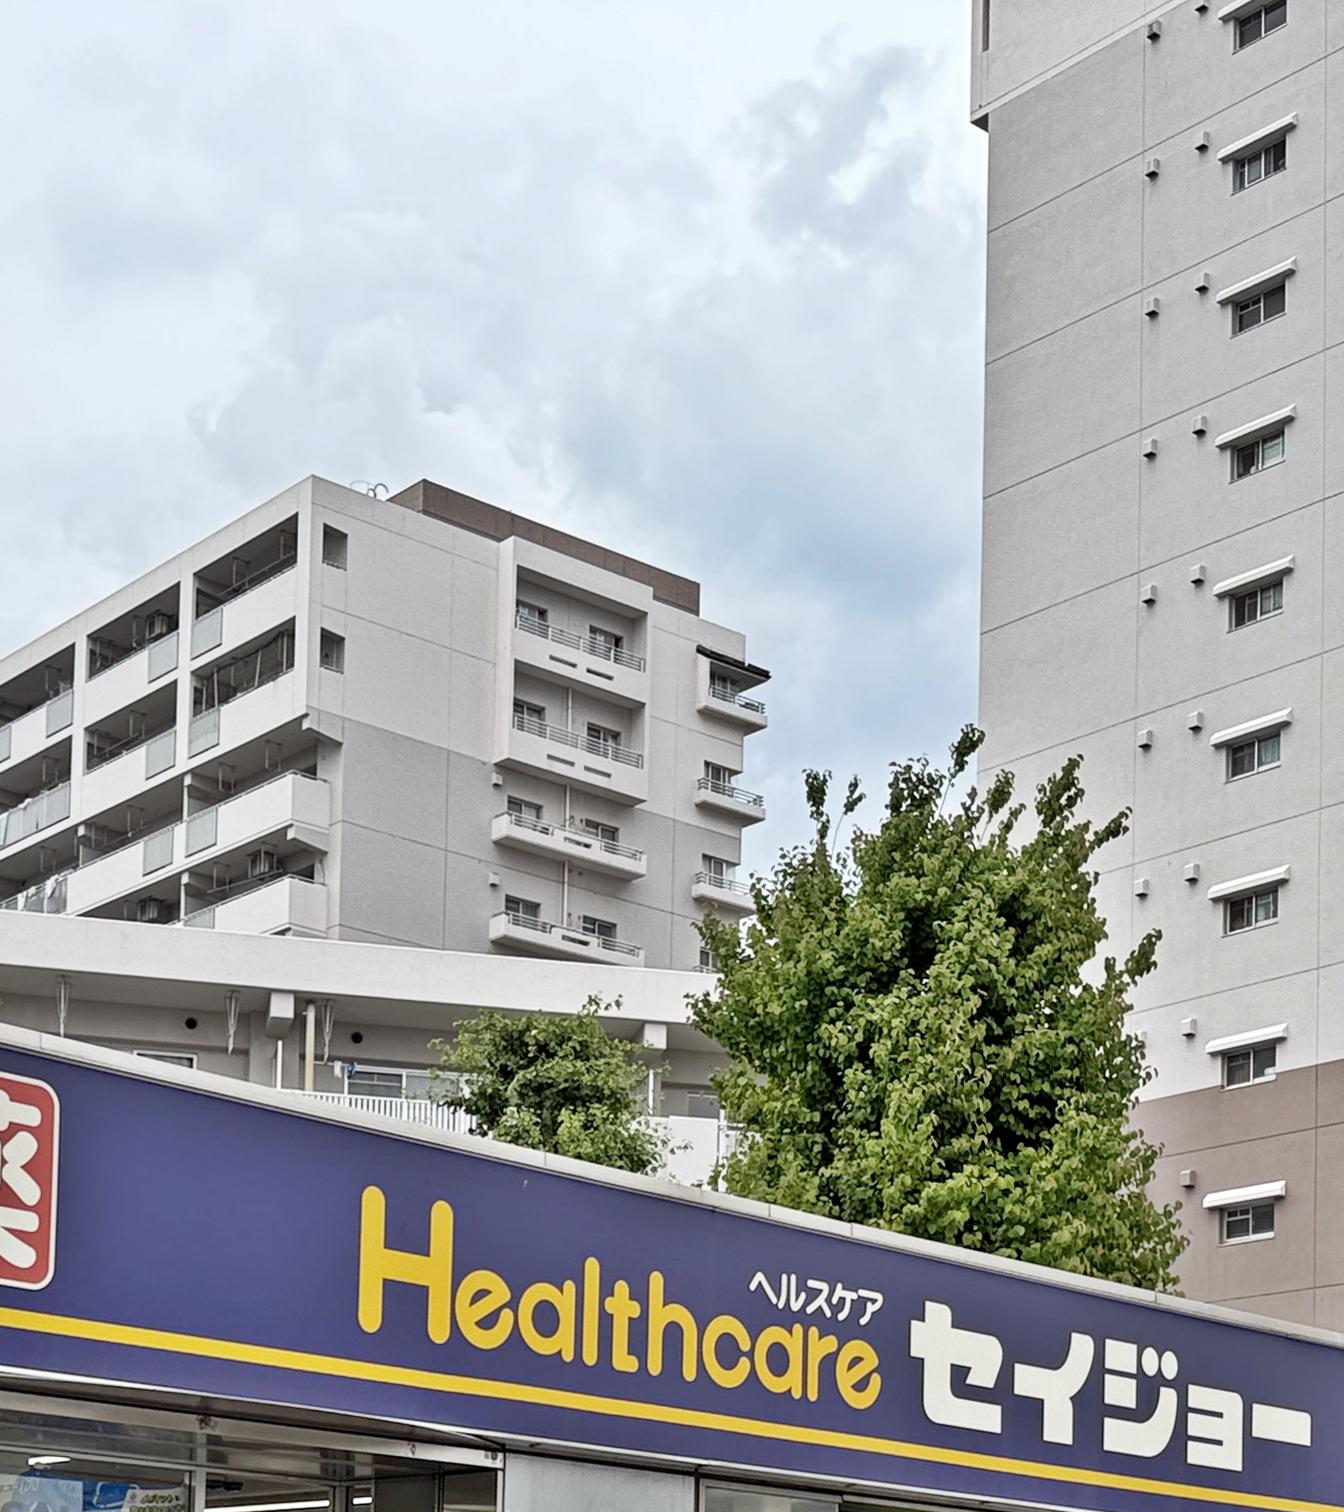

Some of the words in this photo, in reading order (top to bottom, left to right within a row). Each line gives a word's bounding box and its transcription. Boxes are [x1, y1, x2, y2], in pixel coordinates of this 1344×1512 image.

[356, 1184, 882, 1410] Healthcare
[748, 1270, 884, 1326] ヘルスケア
[908, 1300, 1313, 1472] セイジョー
